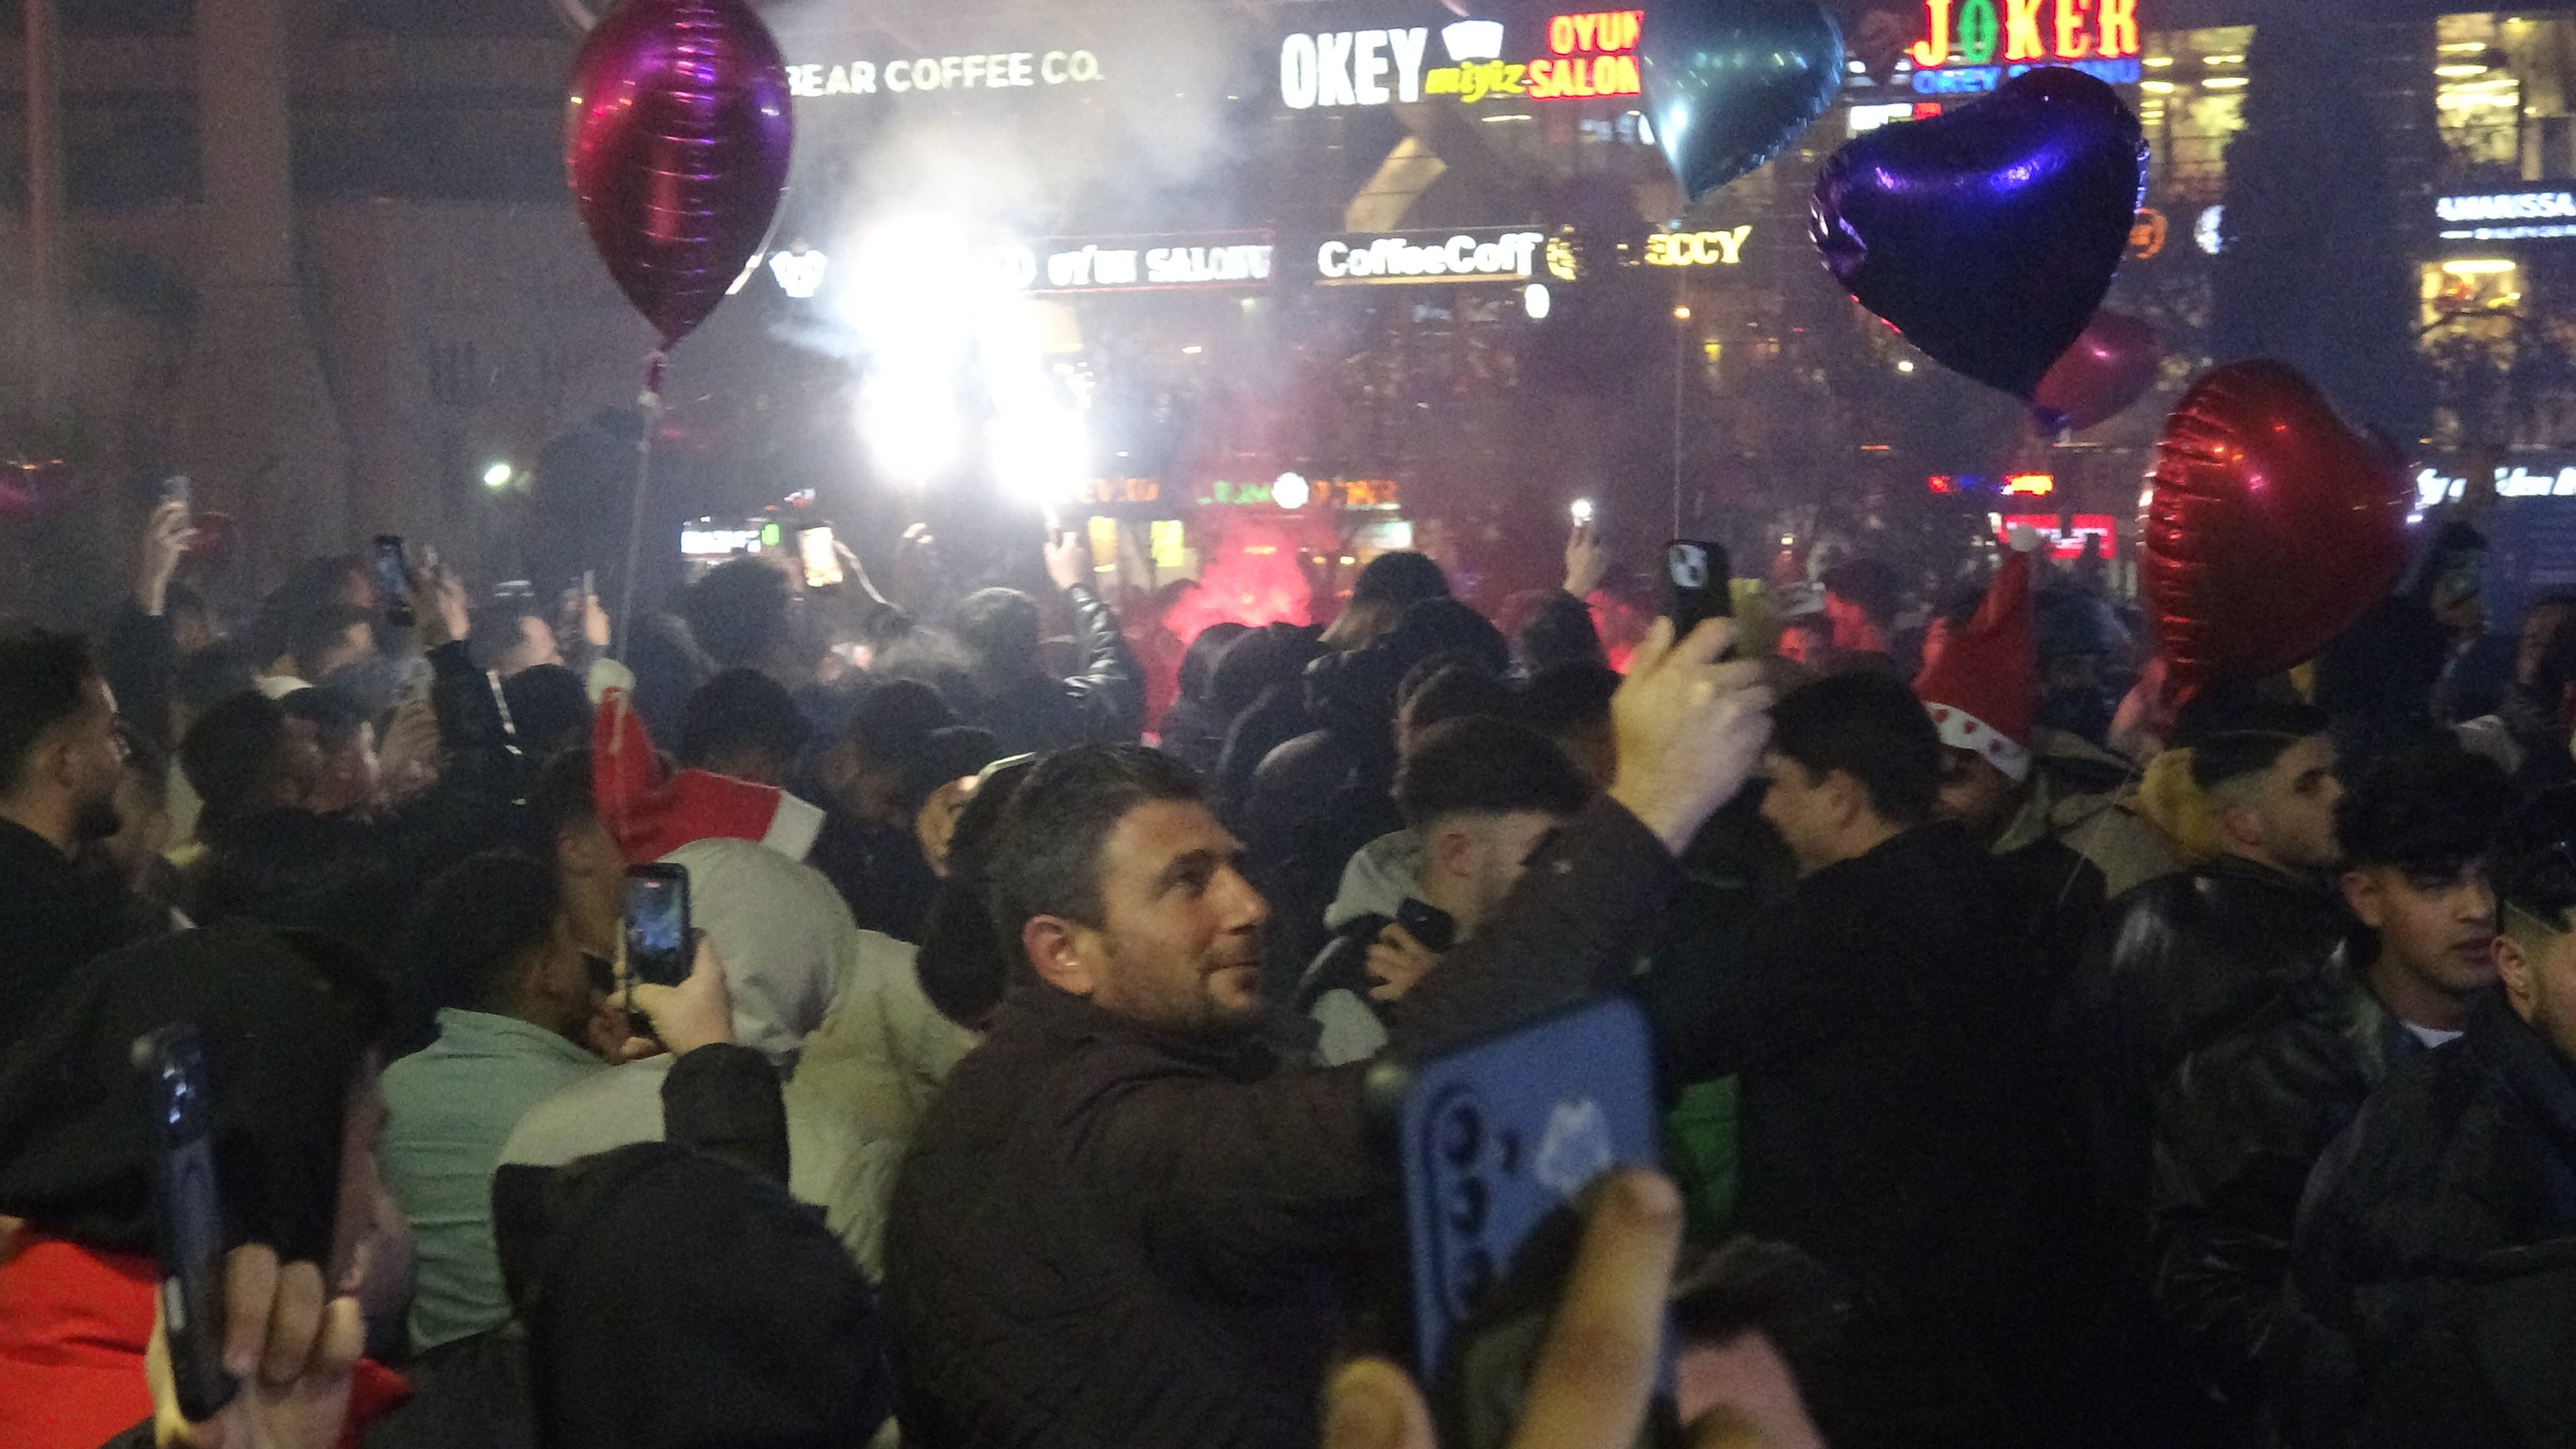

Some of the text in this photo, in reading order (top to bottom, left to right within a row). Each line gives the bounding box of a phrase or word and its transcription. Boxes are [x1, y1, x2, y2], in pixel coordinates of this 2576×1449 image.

[1912, 0, 2141, 67] JOKER
[786, 60, 877, 97] BEAR
[883, 52, 1034, 93] COFFEE
[1280, 27, 1428, 109] OKEY
[1317, 231, 1544, 278] CoffeeCoff
